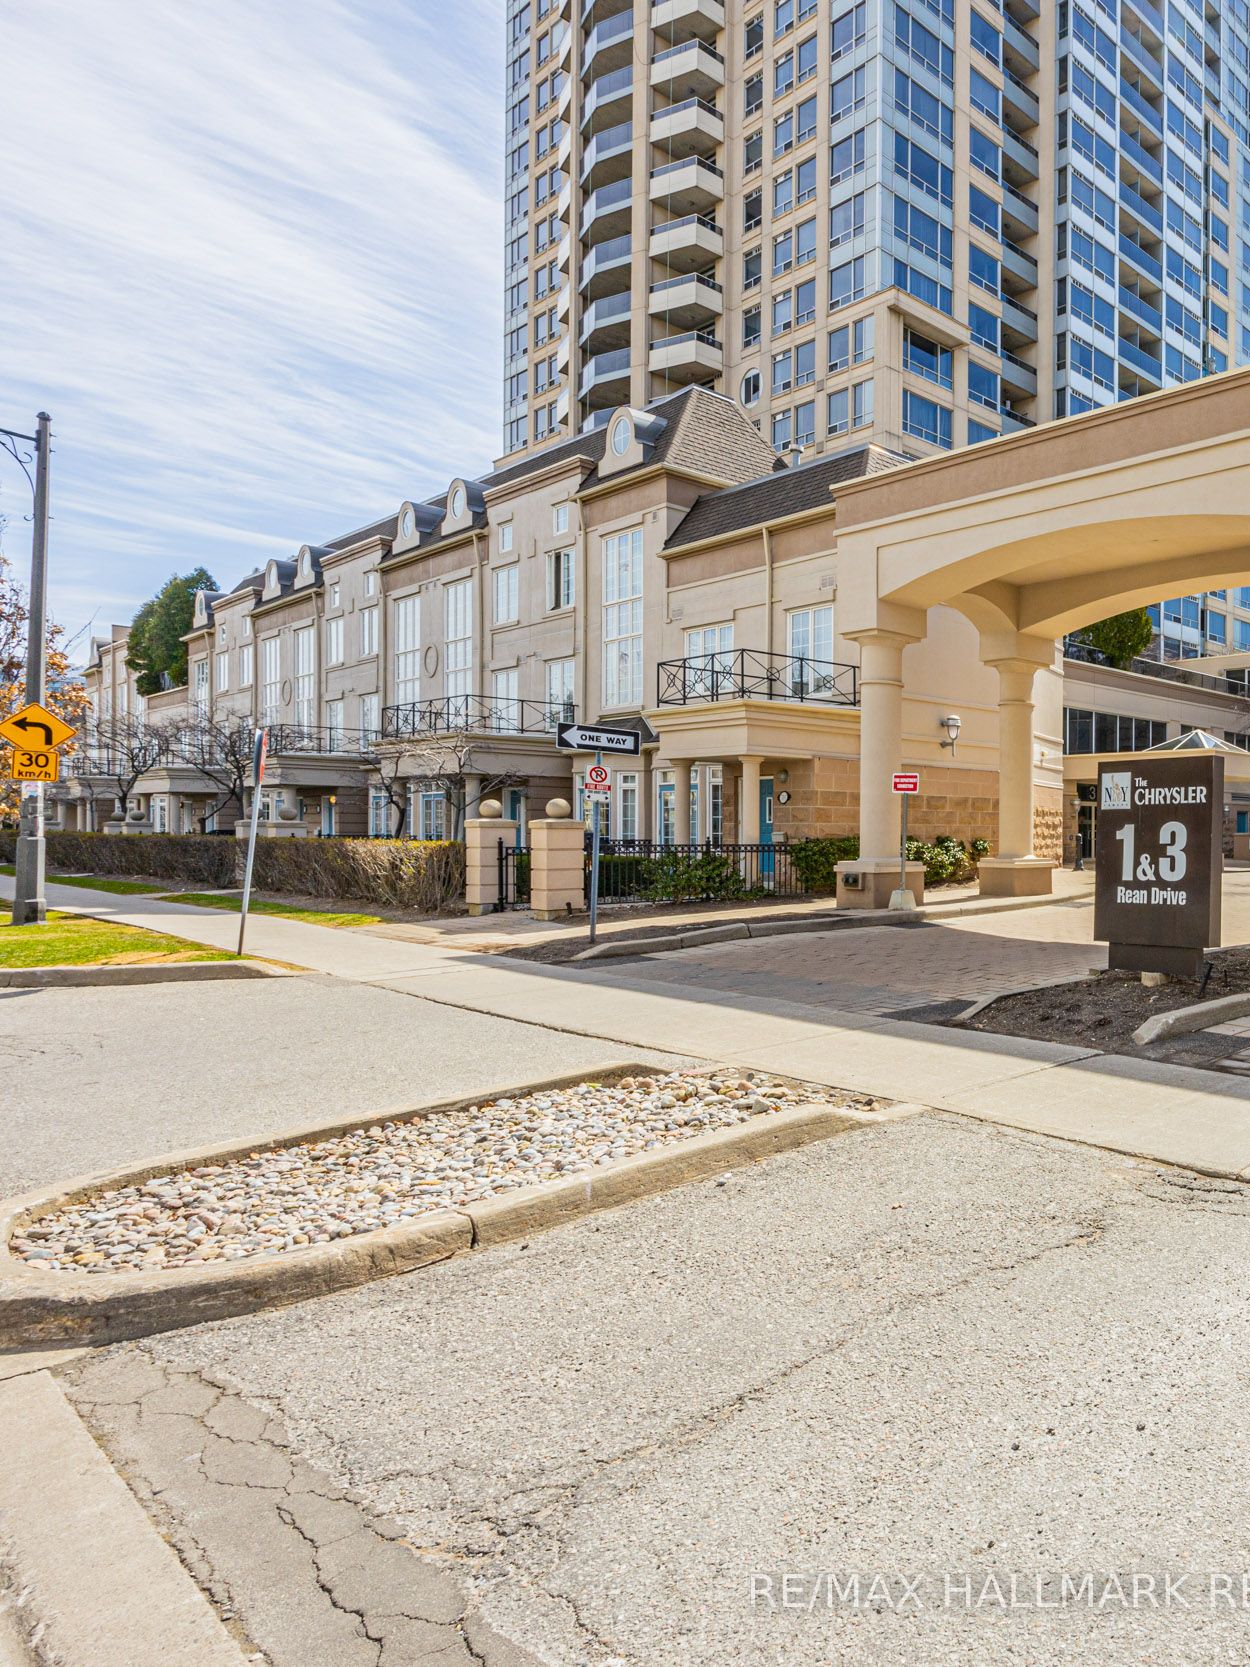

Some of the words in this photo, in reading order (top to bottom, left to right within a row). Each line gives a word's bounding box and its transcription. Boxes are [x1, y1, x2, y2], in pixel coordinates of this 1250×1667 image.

[580, 734, 602, 743] ONE
[606, 736, 627, 746] WAY
[20, 752, 49, 768] 30
[17, 769, 52, 779] km/h
[1089, 786, 1096, 800] 3
[1134, 786, 1207, 805] CHRYSLER
[1116, 886, 1147, 904] Rean
[1151, 887, 1187, 905] Drive
